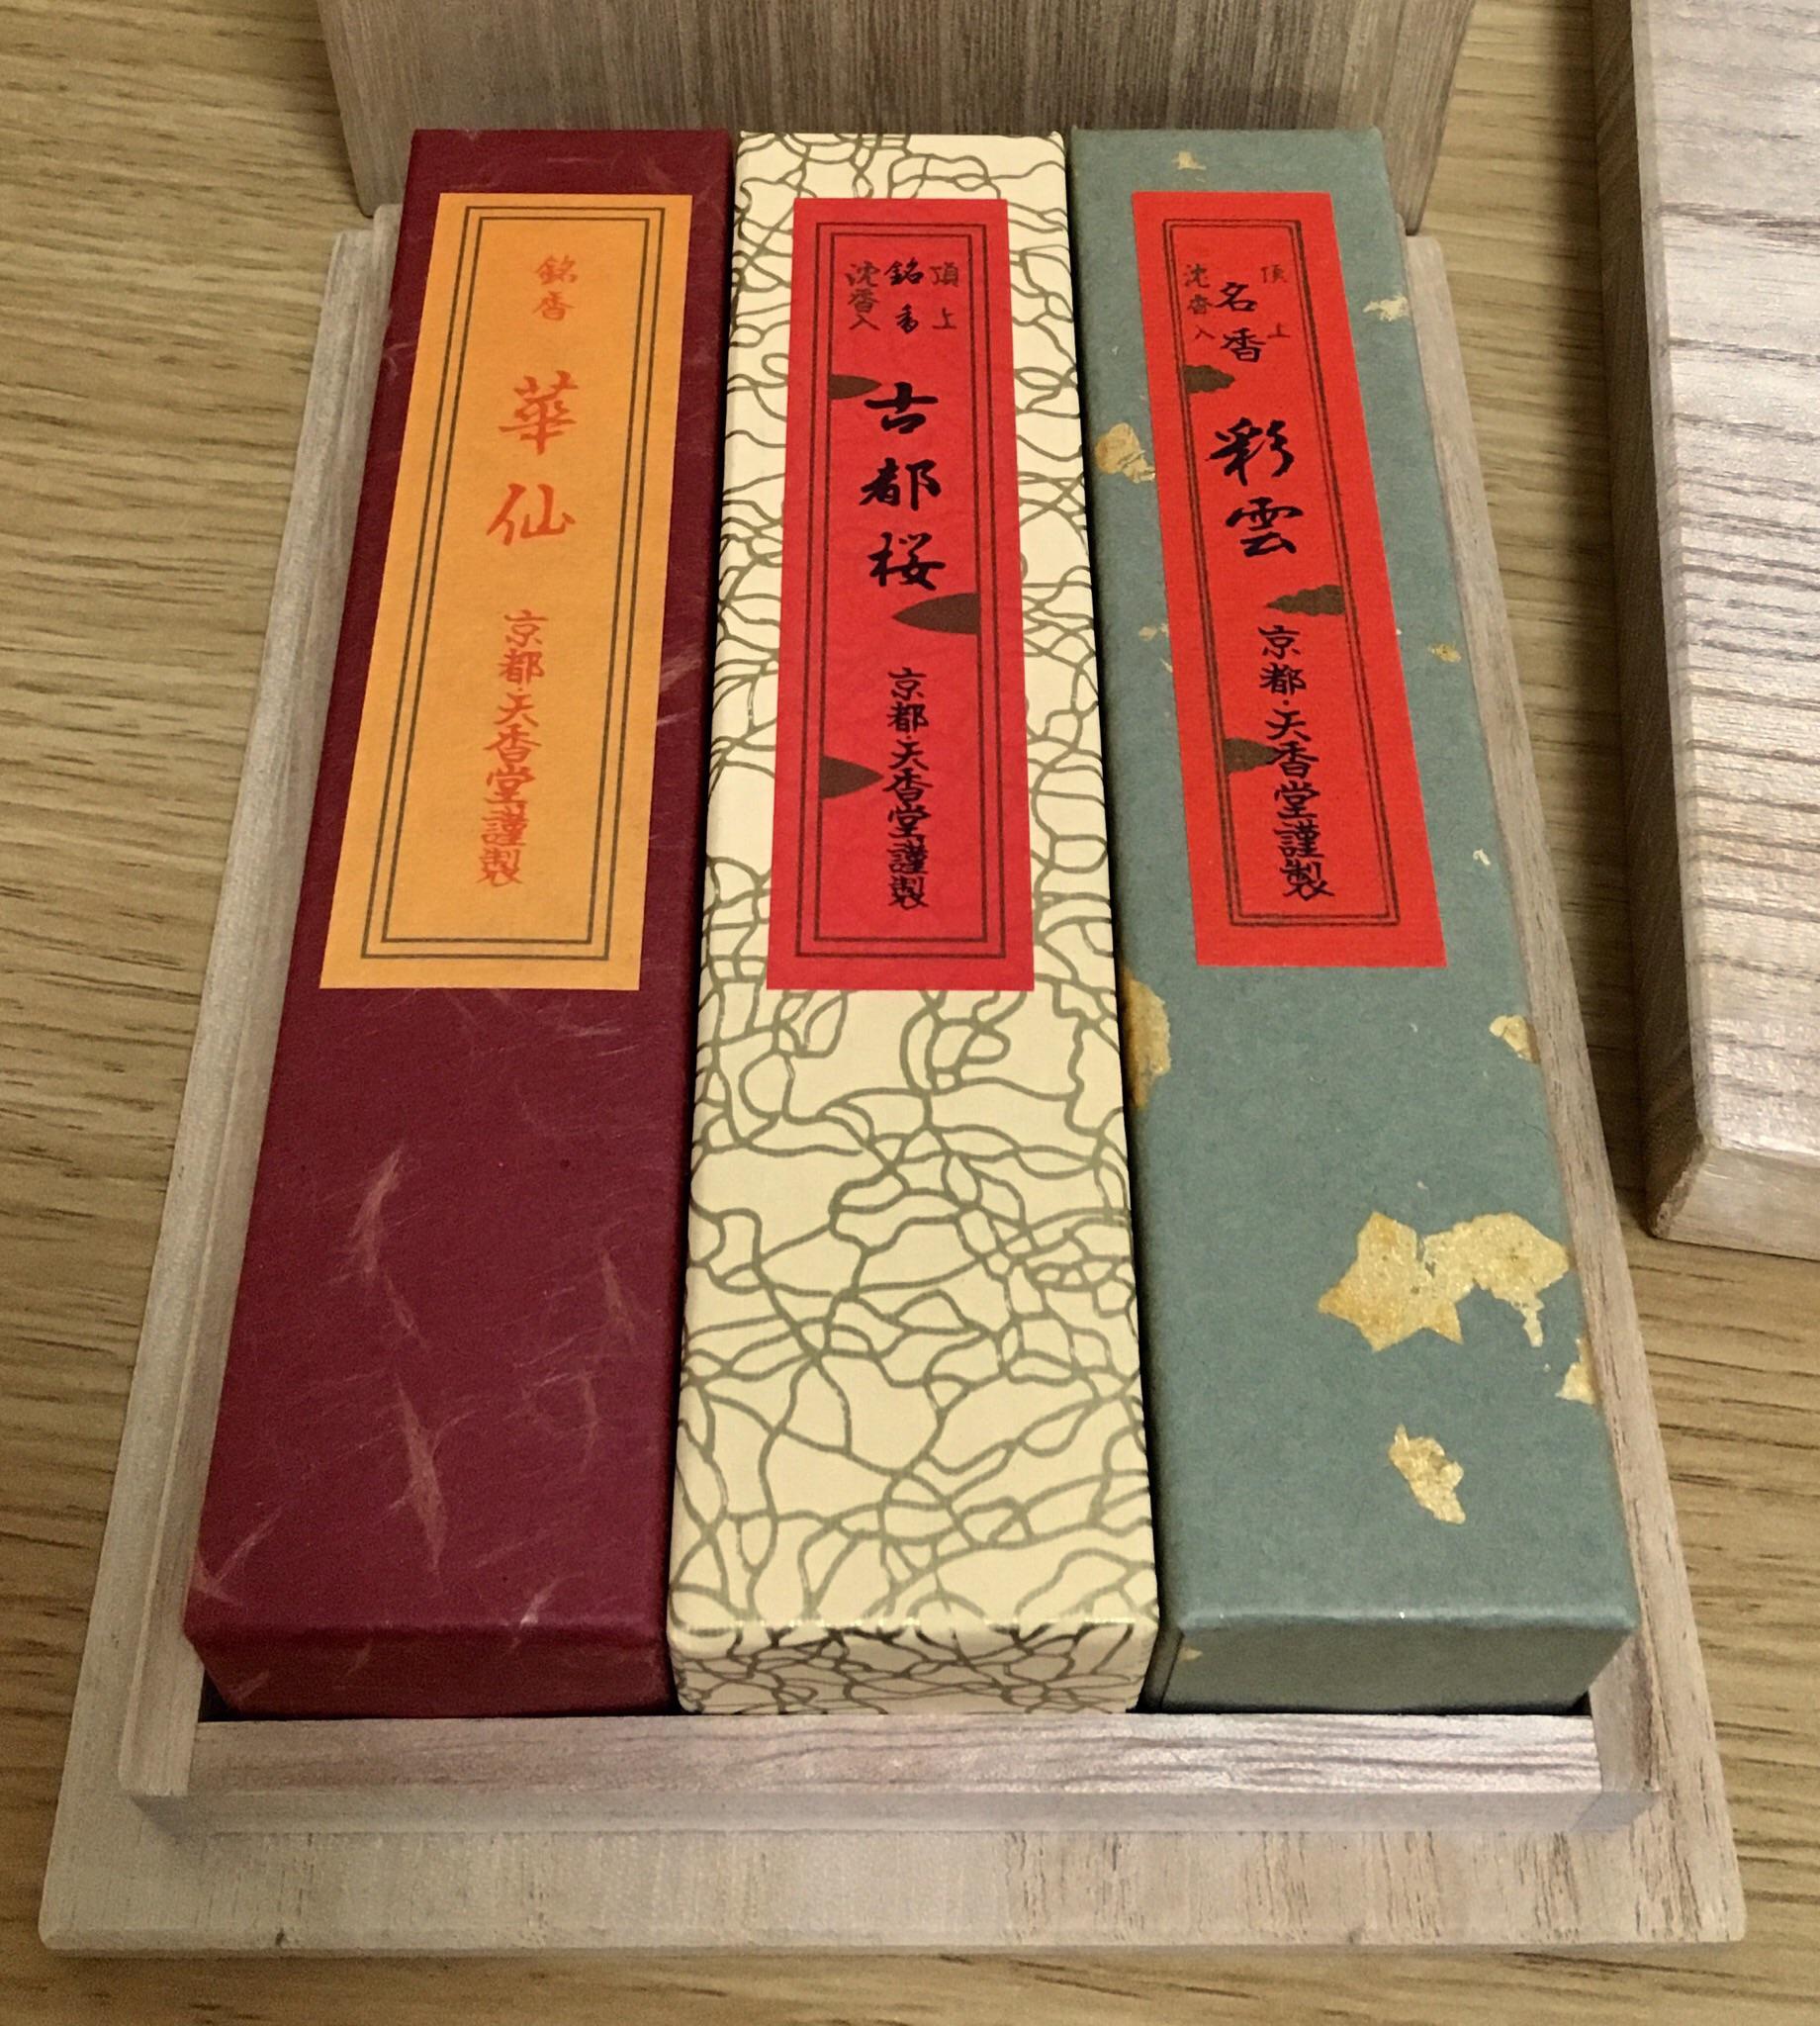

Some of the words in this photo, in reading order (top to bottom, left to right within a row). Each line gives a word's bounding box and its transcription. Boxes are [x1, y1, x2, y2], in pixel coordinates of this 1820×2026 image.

[533, 253, 579, 322] 銘香
[845, 261, 881, 331] 沈香入
[884, 256, 925, 334] 銘香
[929, 264, 960, 330] 頂上
[1183, 263, 1216, 341] 沈香入
[1215, 282, 1266, 363] 名香
[1261, 265, 1291, 338] 頂上
[486, 369, 579, 546] 華仙
[858, 381, 947, 591] 古都桜
[1206, 416, 1304, 558] 彩雲
